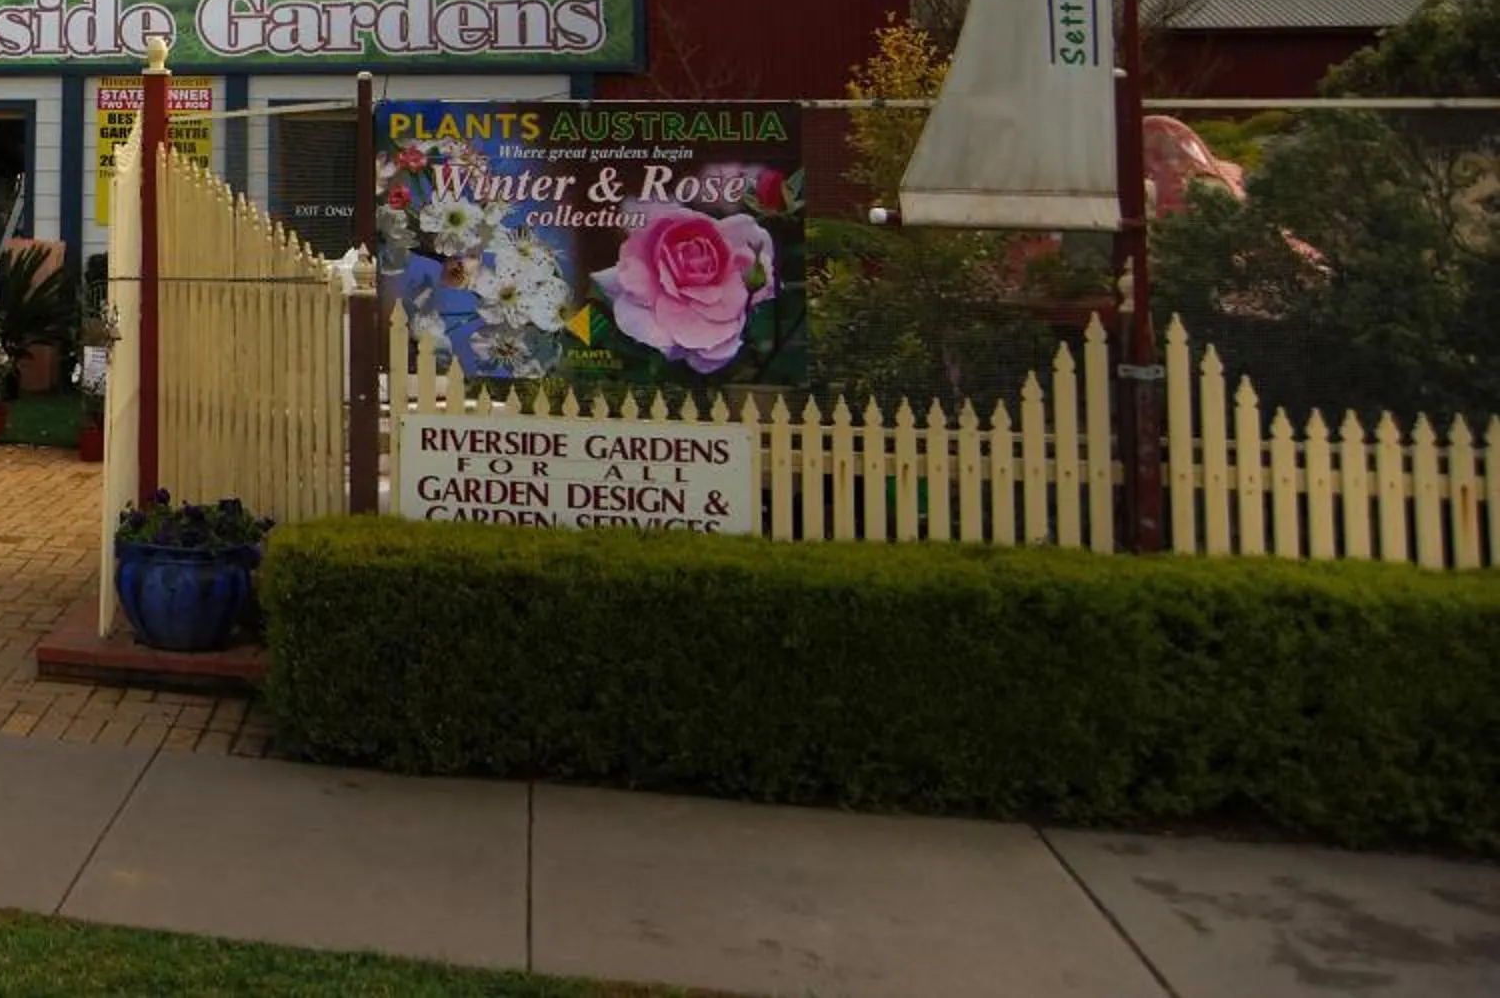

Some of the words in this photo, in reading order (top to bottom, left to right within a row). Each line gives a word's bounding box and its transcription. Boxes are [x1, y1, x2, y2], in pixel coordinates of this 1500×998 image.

[100, 89, 145, 101] STATE
[167, 127, 209, 139] ENTRE
[388, 112, 541, 140] PLANTS
[548, 110, 789, 142] AUSTRALIA
[499, 145, 546, 159] Where
[548, 146, 587, 162] great
[589, 146, 649, 162] gardens
[652, 146, 694, 162] begin
[430, 162, 577, 204] Winter
[587, 163, 625, 205] &
[638, 164, 747, 205] Rose
[295, 205, 319, 216] EXIT
[325, 205, 355, 217] ONLY
[525, 205, 647, 229] collection
[421, 427, 567, 458] RIVERSIDE
[585, 435, 730, 464] GARDENS
[457, 457, 549, 477] FOR
[604, 465, 692, 483] ALL
[418, 476, 549, 507] GARDEN
[567, 483, 685, 514] DESIGN
[703, 489, 730, 516] &
